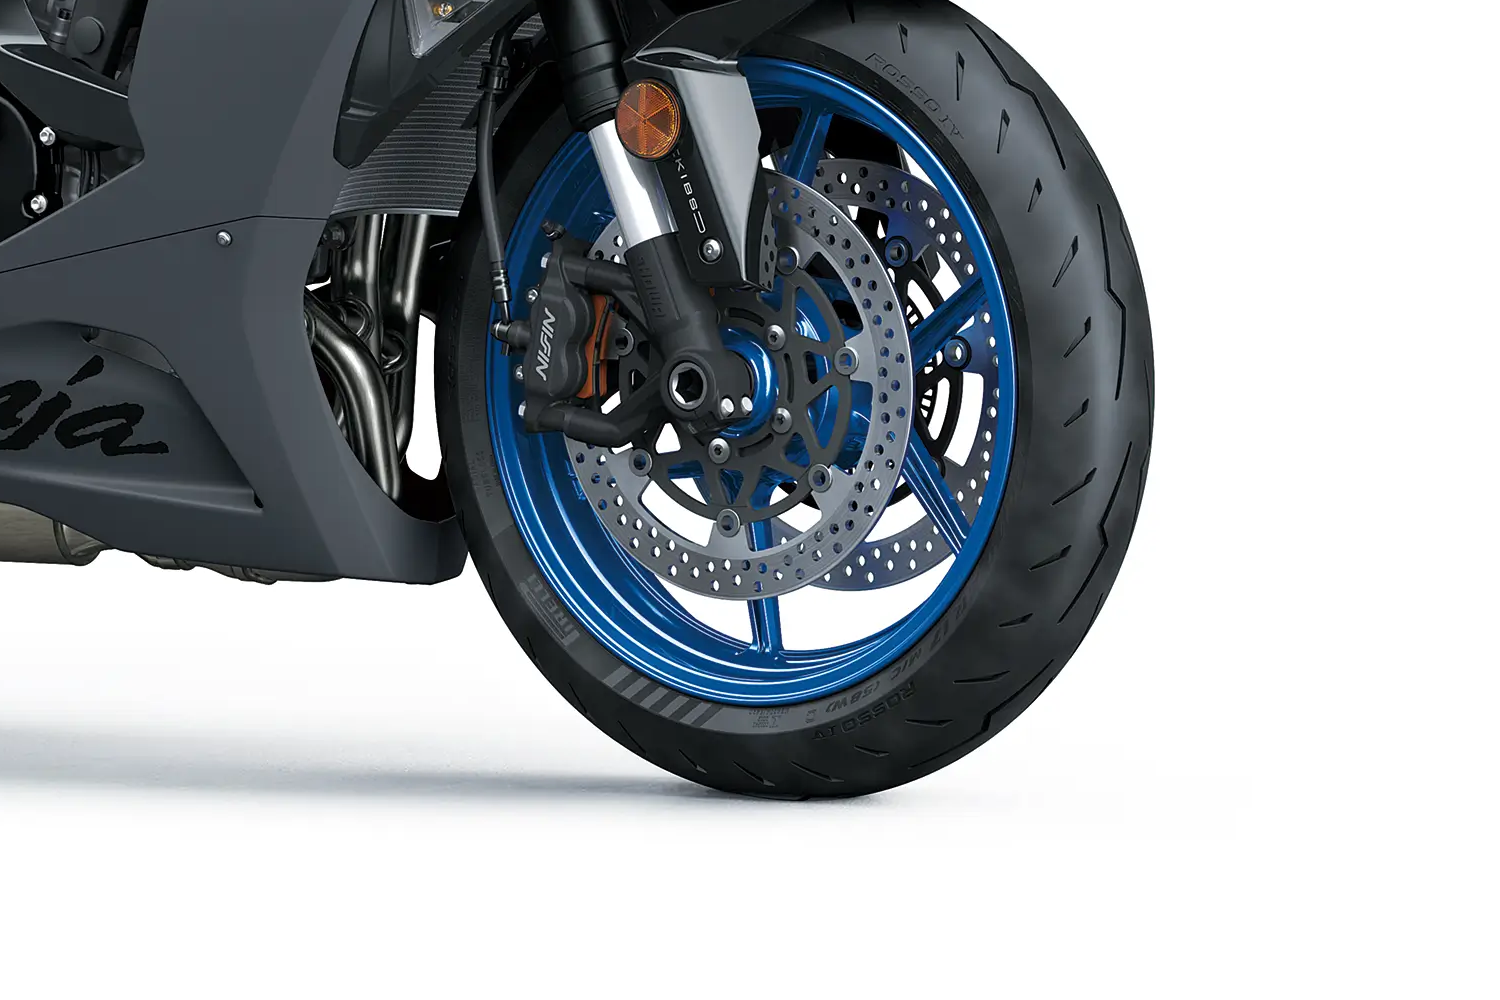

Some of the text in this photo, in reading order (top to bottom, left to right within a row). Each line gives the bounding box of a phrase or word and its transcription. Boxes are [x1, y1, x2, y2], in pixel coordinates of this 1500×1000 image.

[865, 52, 941, 112] ROSSO
[675, 158, 699, 211] KIBS
[517, 573, 580, 647] PIRELLI
[840, 675, 918, 733] ROSSO
